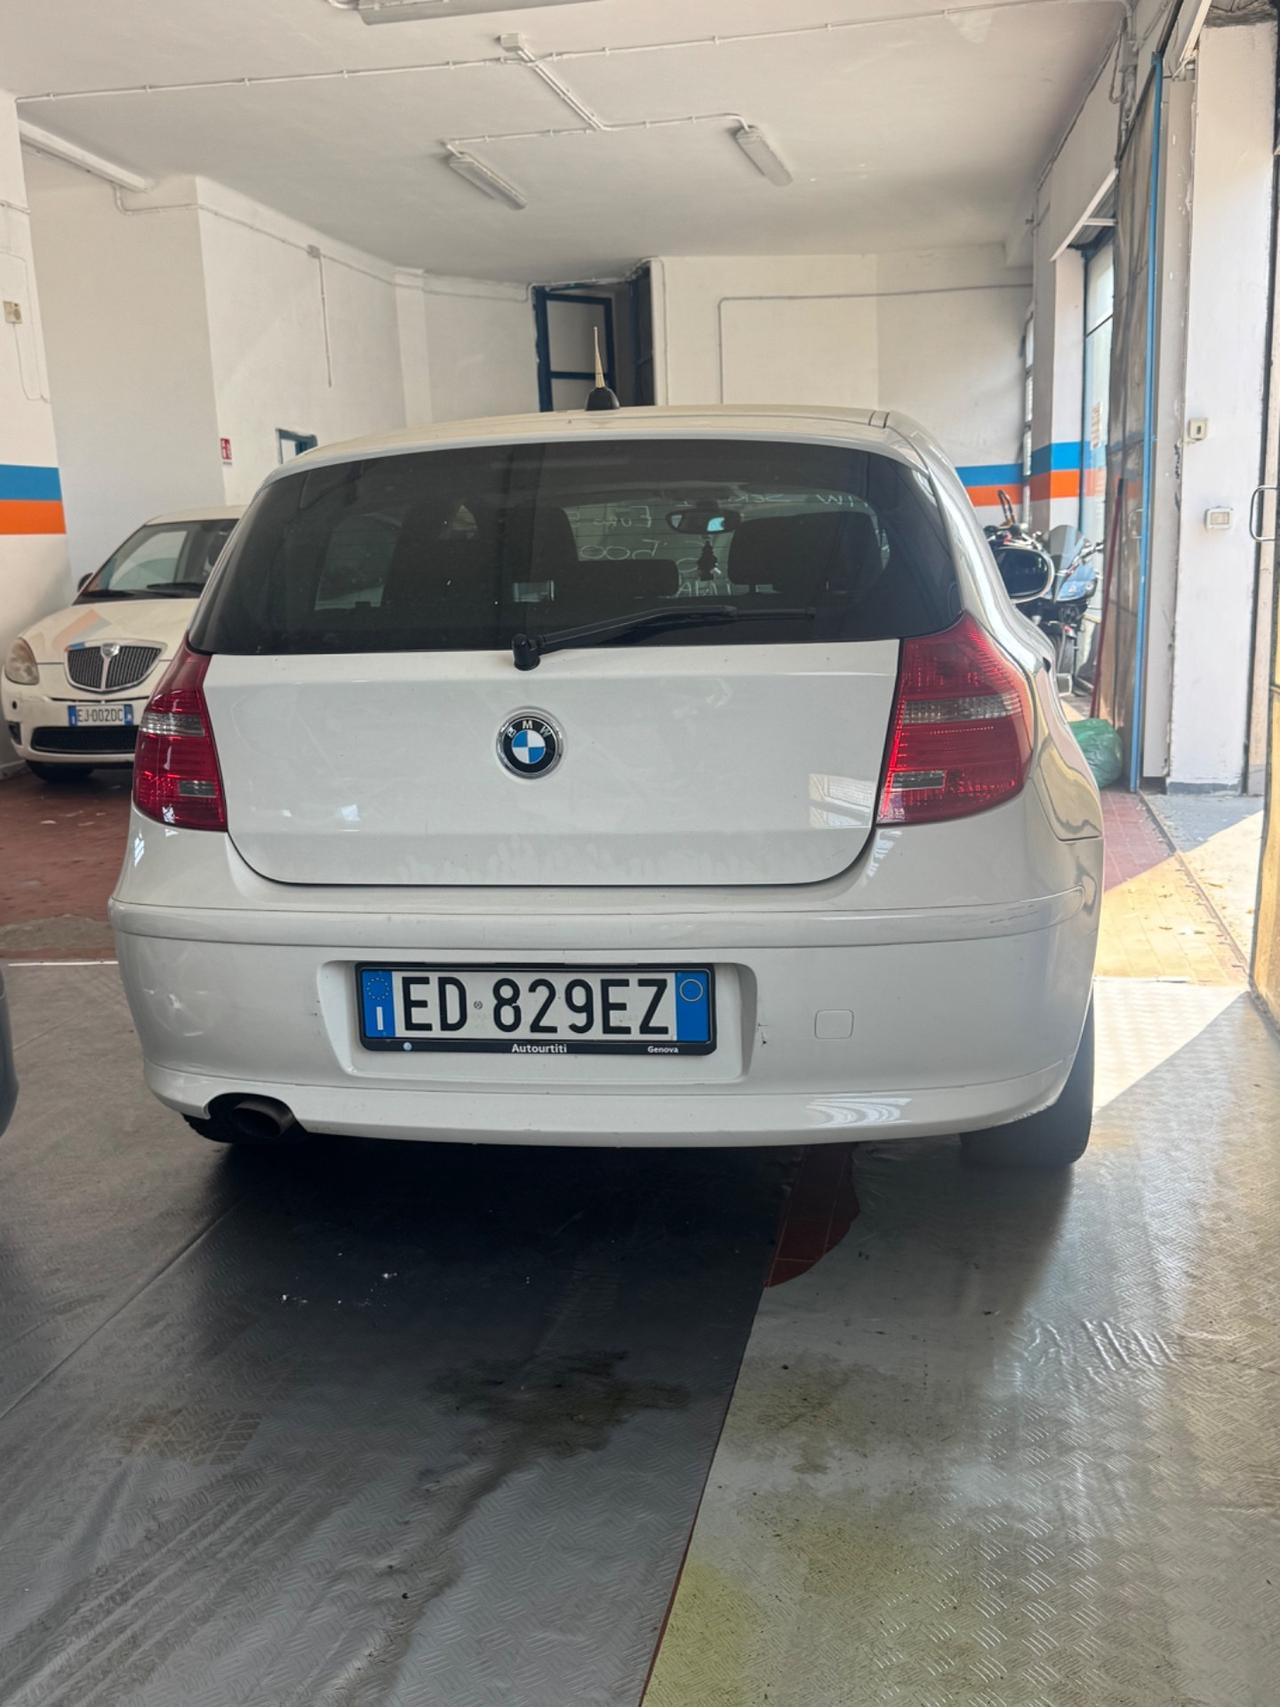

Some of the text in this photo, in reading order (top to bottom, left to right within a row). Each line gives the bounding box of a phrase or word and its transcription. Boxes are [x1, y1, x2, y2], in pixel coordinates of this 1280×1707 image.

[506, 720, 552, 738] BMW
[401, 976, 467, 1032] ED
[492, 977, 669, 1035] 829EZ
[512, 1044, 567, 1054] Autourtiti
